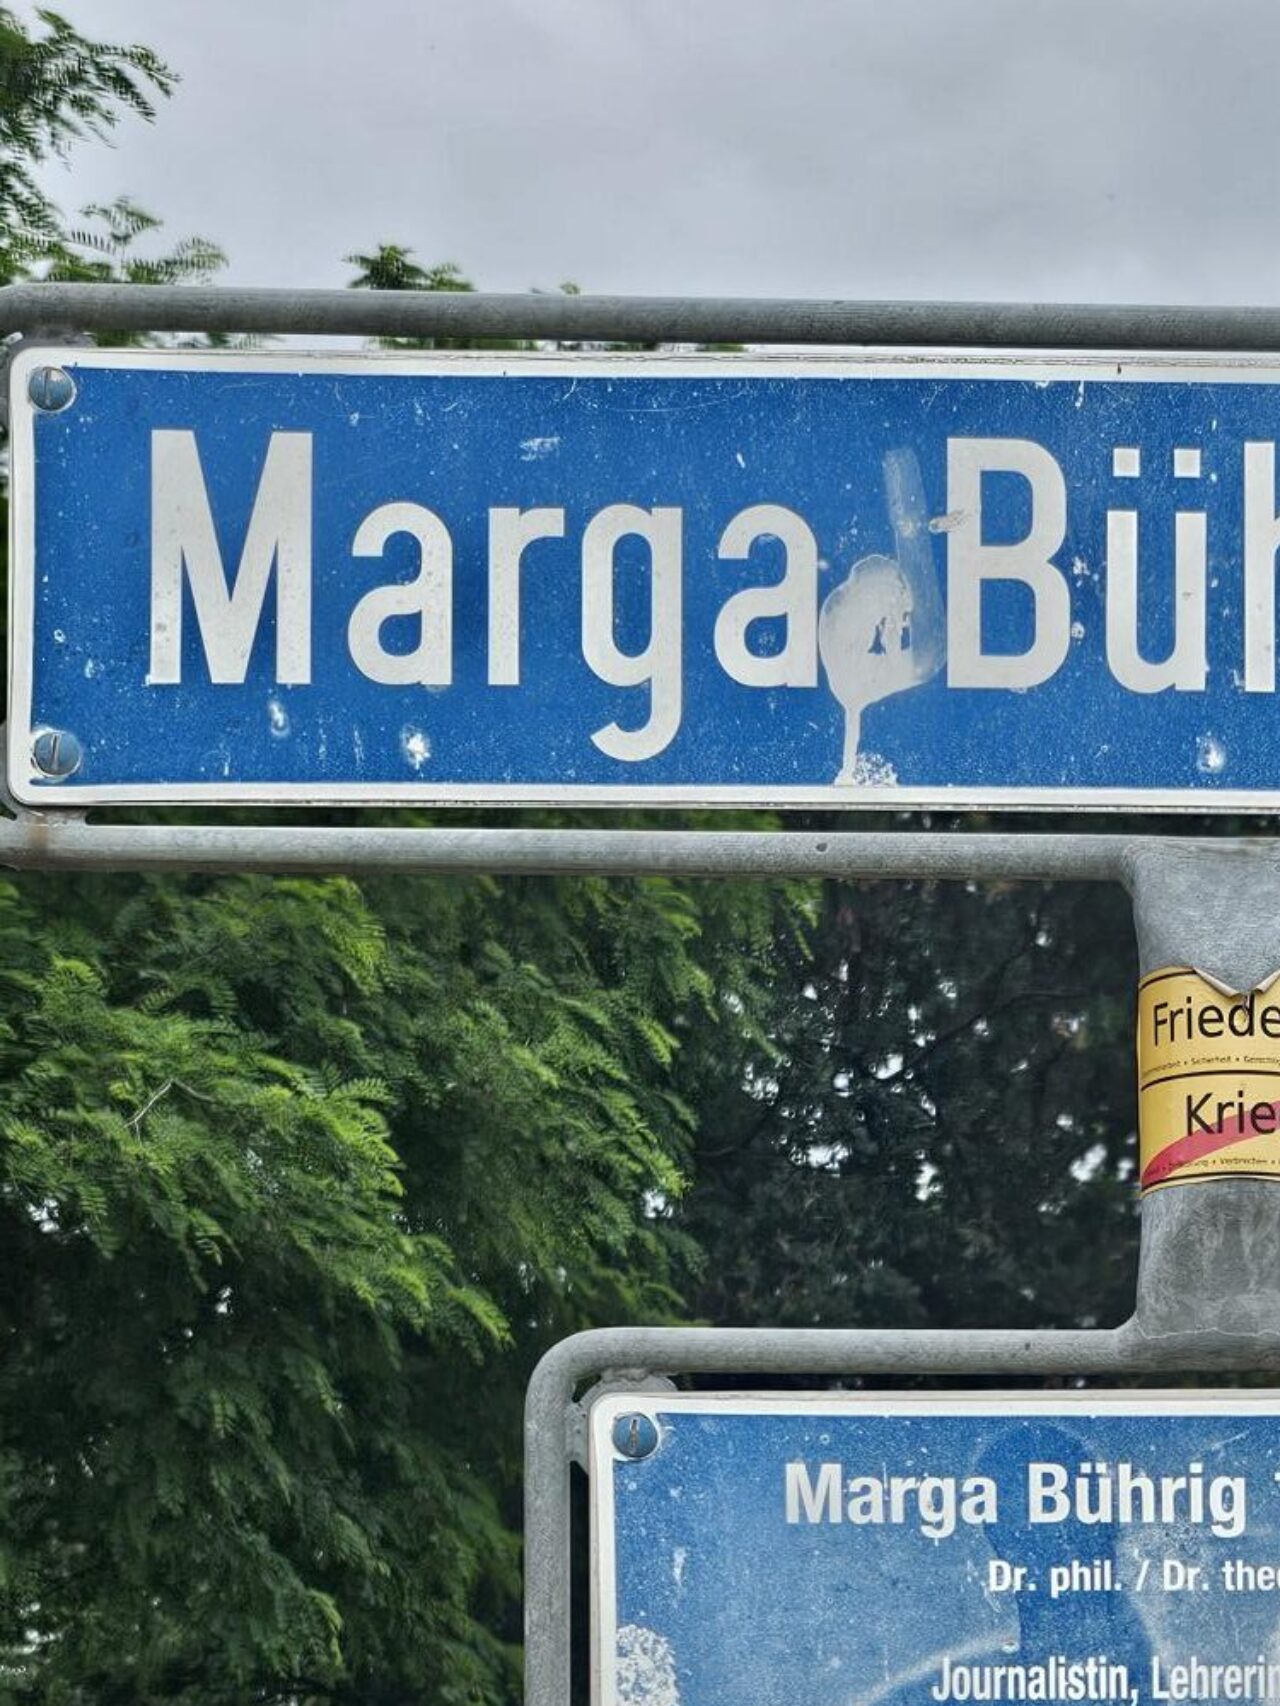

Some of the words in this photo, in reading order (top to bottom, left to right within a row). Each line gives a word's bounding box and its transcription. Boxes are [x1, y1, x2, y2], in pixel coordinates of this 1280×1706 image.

[148, 428, 819, 763] Marga
[784, 1462, 998, 1539] Marga
[1027, 1461, 1247, 1539] Bührig
[987, 1560, 1037, 1592] Dr.
[1050, 1559, 1123, 1599] phil.
[1135, 1560, 1150, 1593] /
[1162, 1560, 1210, 1592] Dr.
